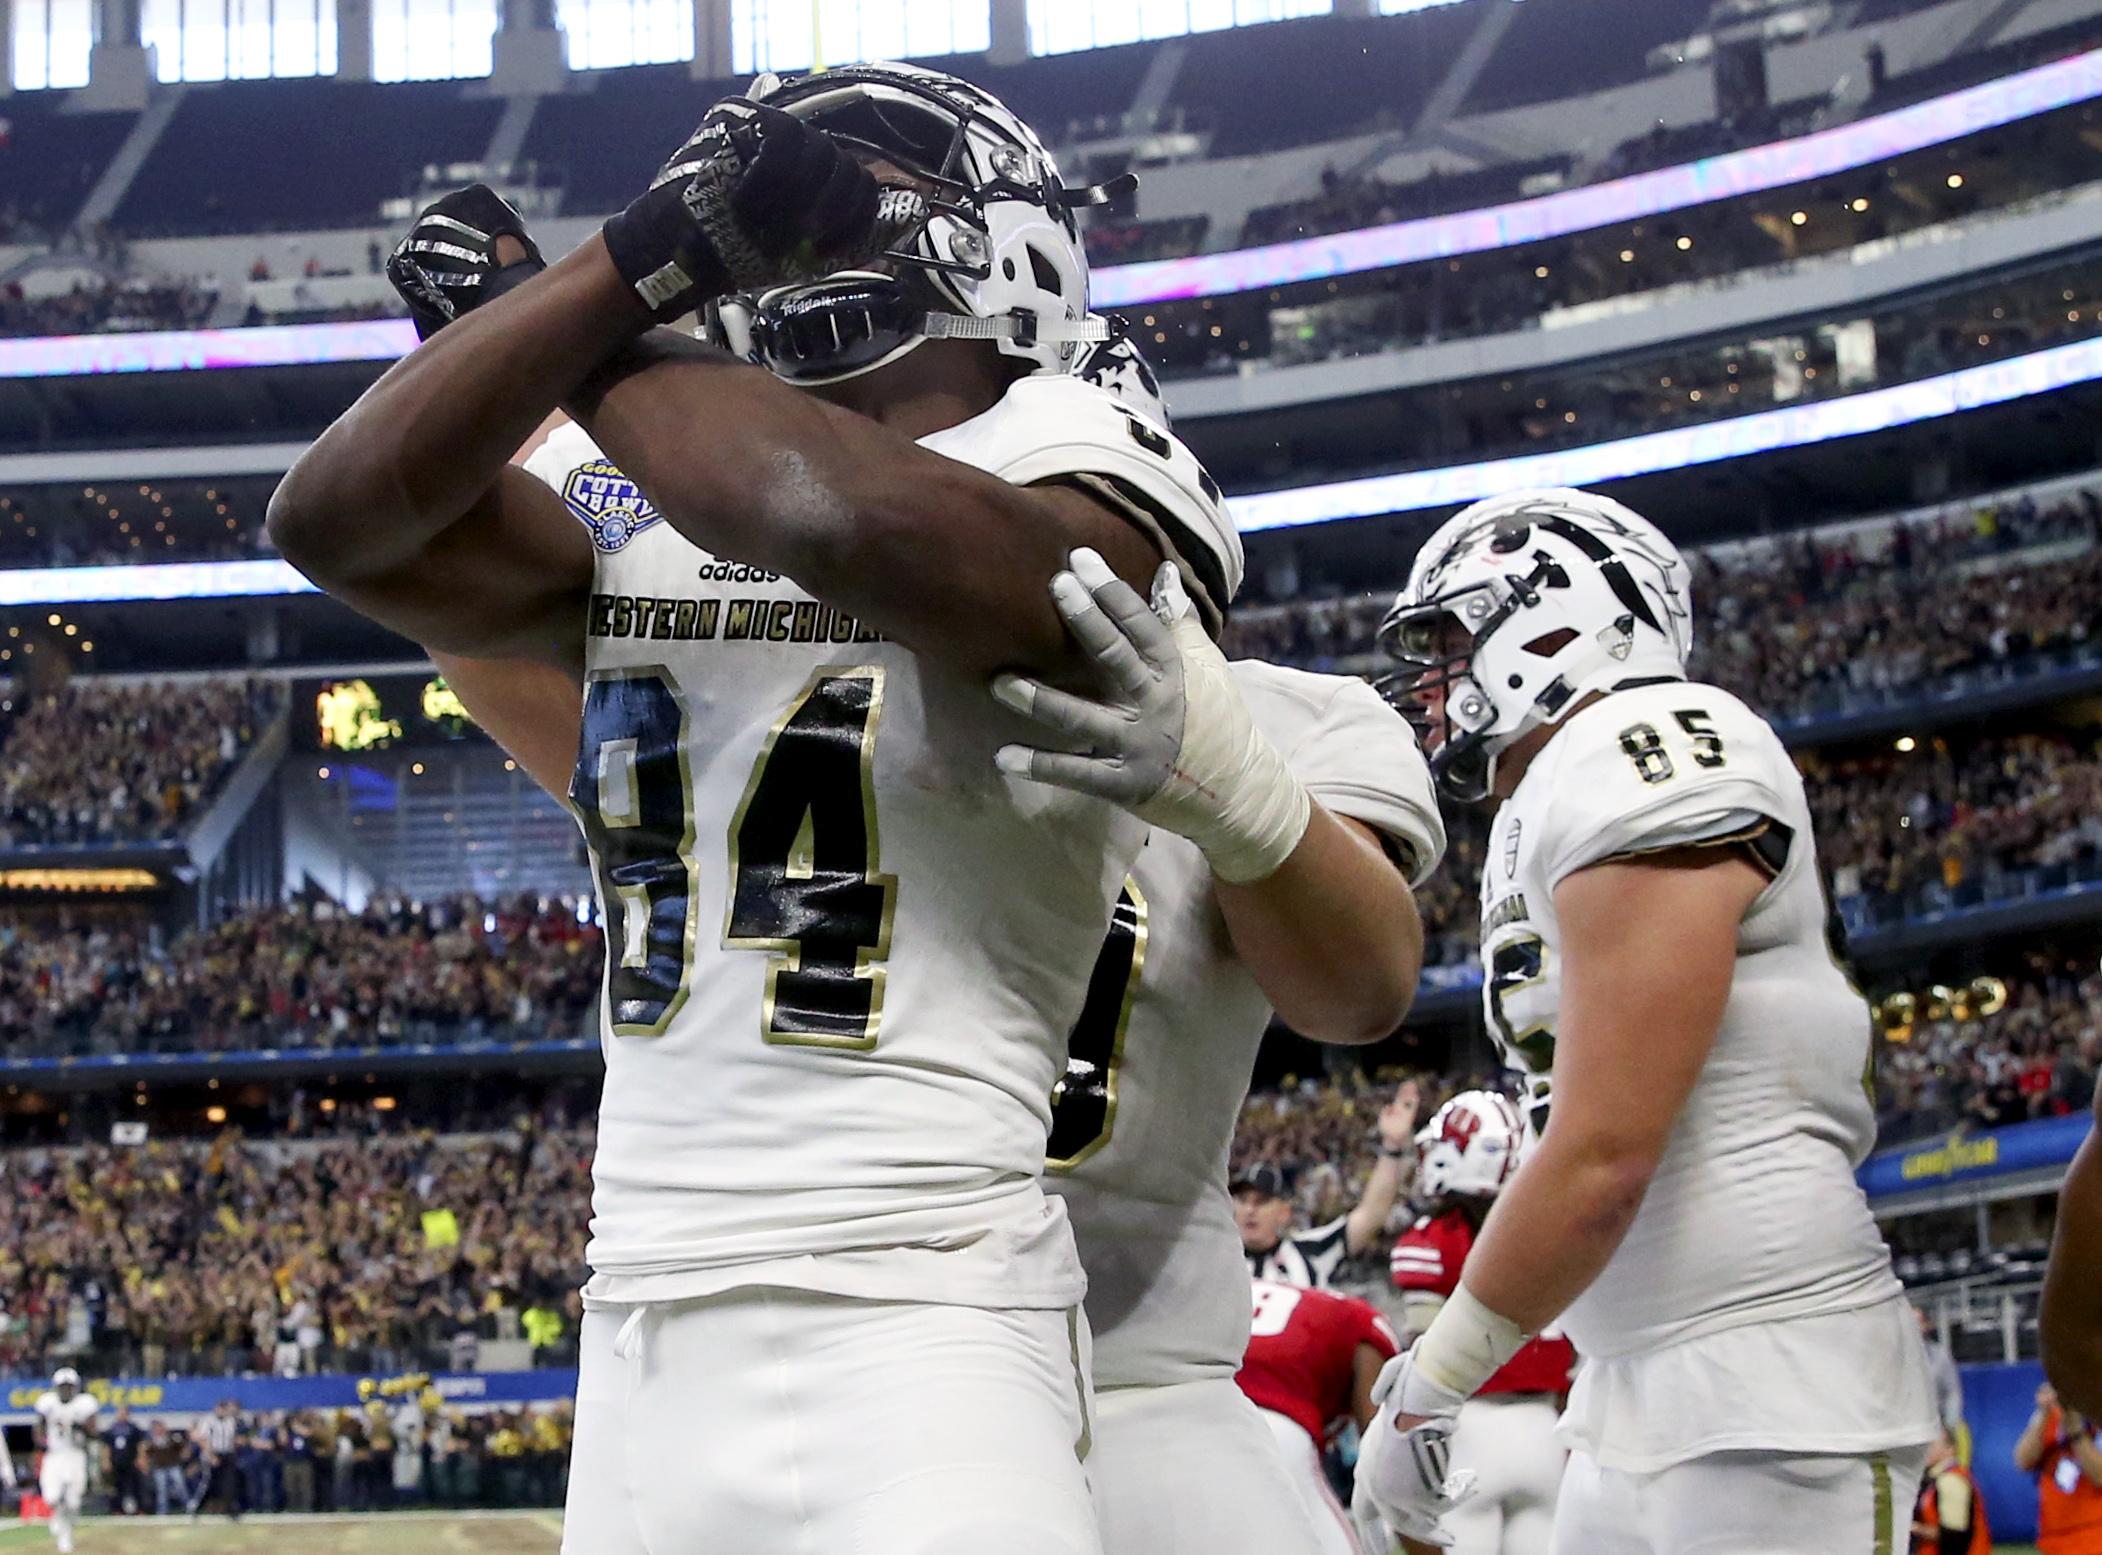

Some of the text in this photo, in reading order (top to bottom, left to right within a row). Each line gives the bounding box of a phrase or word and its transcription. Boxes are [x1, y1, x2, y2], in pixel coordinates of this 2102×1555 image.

[572, 473, 641, 505] COTT
[597, 510, 635, 528] CLASSIC
[699, 560, 780, 583] adidas
[589, 592, 721, 640] ESTERN
[1617, 708, 1726, 787] 85
[570, 664, 898, 1051] 84
